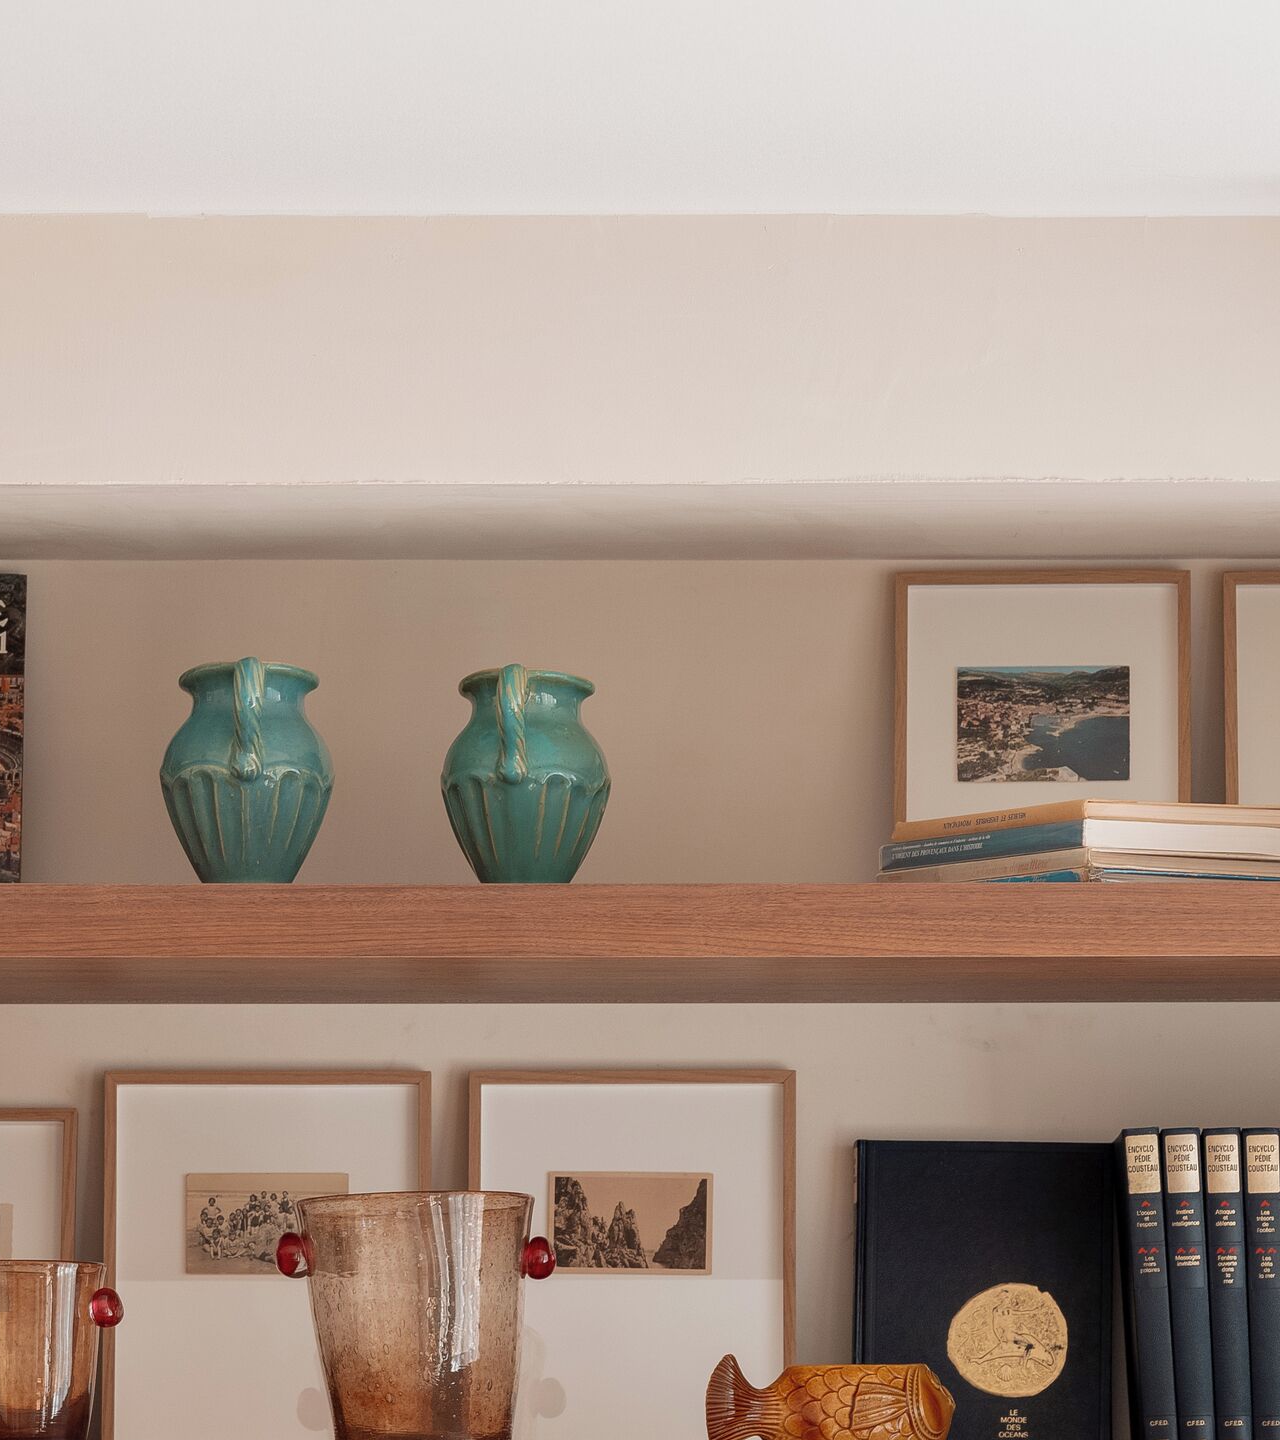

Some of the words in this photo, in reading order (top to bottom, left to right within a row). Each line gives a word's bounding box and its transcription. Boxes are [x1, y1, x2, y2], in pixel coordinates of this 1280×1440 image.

[1135, 1154, 1151, 1162] PÉDIE
[1174, 1154, 1190, 1162] PÉDIE
[1214, 1154, 1231, 1162] PÉDIE
[1254, 1154, 1271, 1162] PÉDIE
[1128, 1165, 1158, 1173] COUSTEAU
[1168, 1164, 1197, 1172] COUSTEAU
[1208, 1164, 1238, 1172] COUSTEAU
[1248, 1164, 1278, 1172] COUSTEAU
